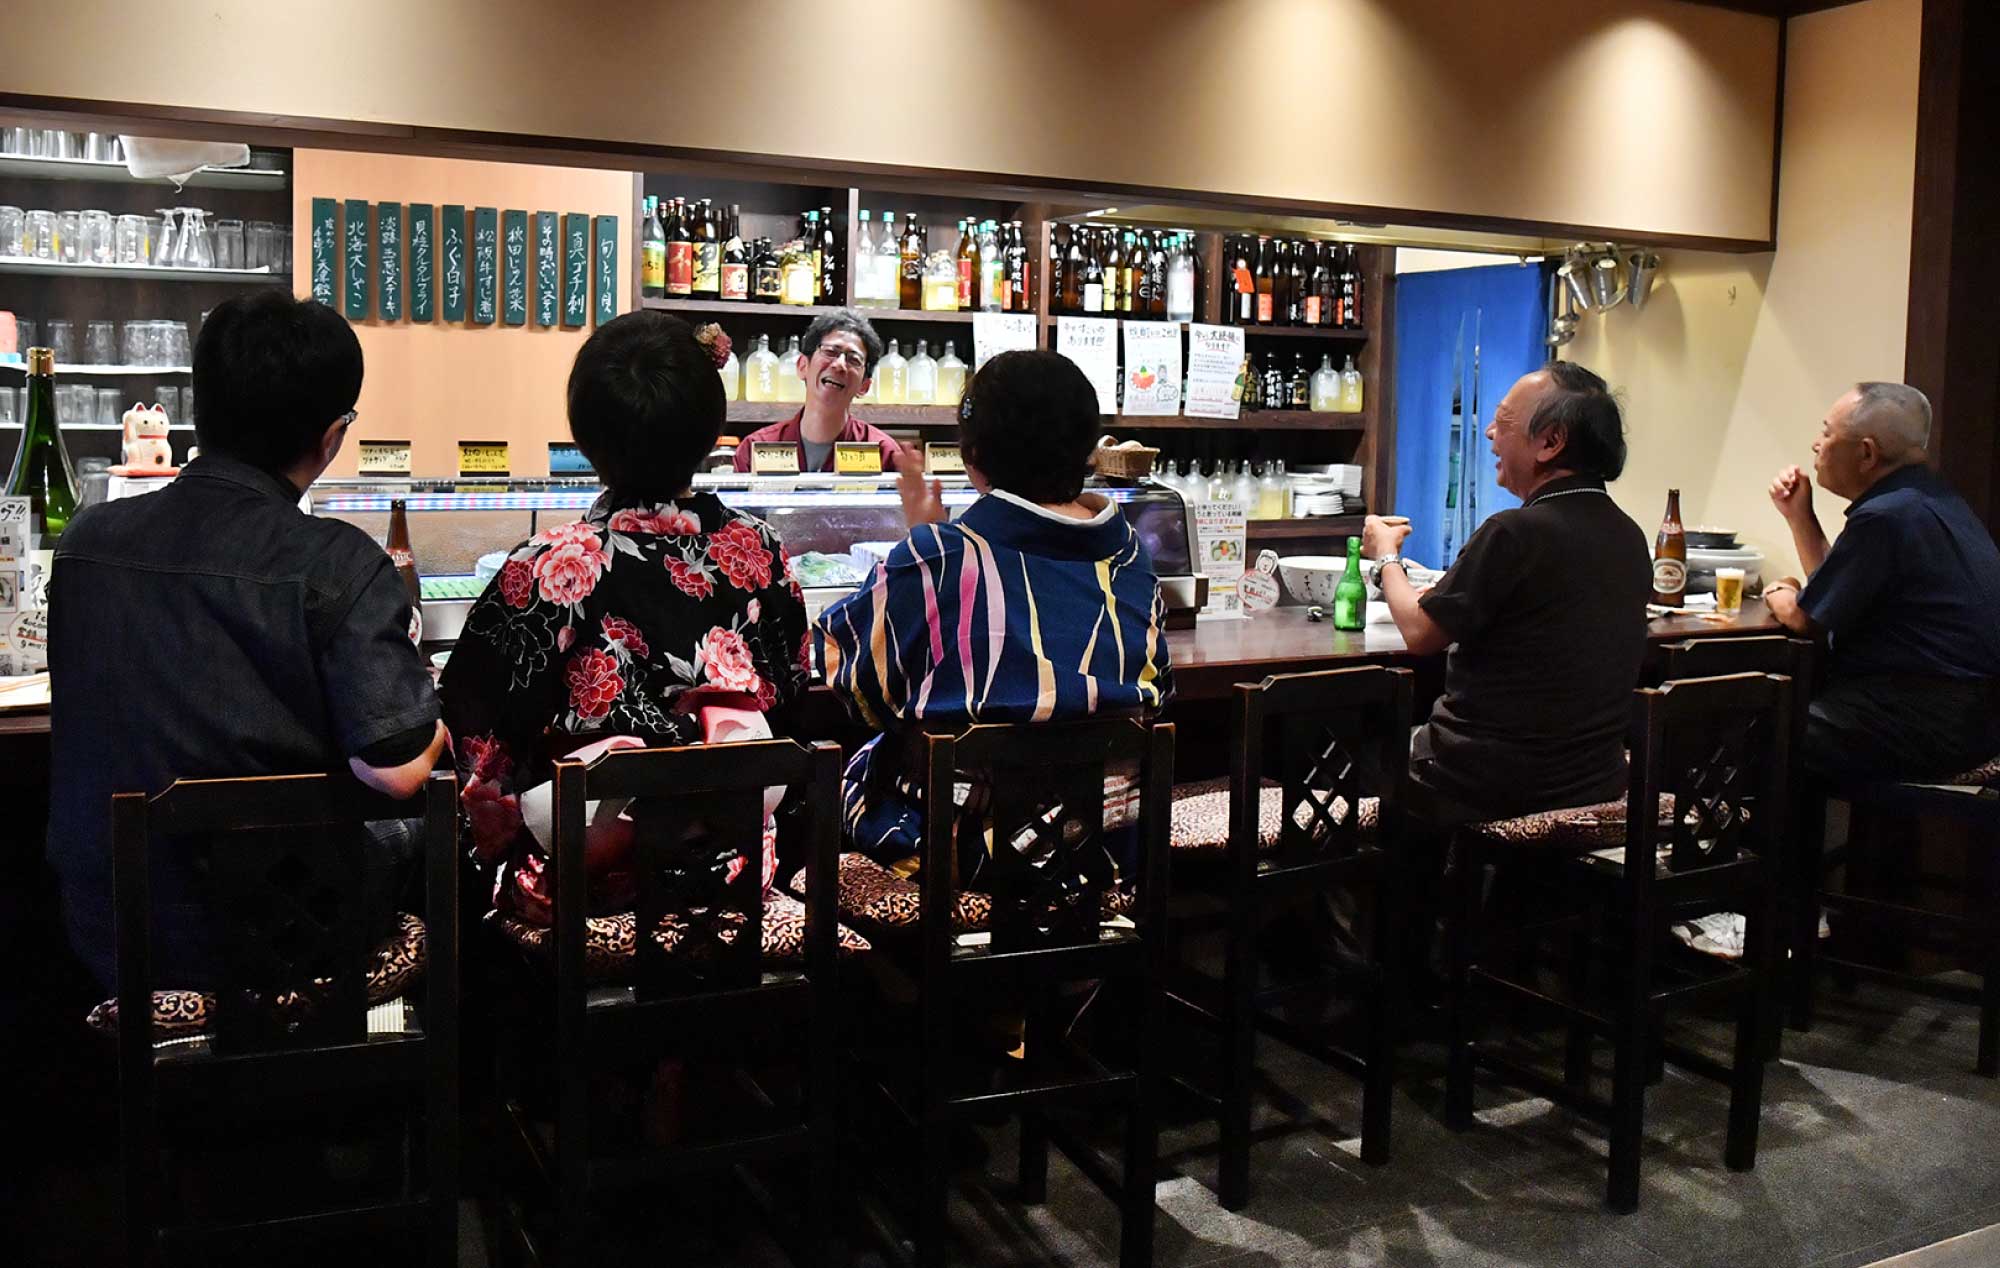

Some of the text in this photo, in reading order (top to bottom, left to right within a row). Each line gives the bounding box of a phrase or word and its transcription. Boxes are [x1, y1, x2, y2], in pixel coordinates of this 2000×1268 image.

[445, 228, 464, 309] ふぐ白子
[600, 238, 615, 315] 旬とり貝
